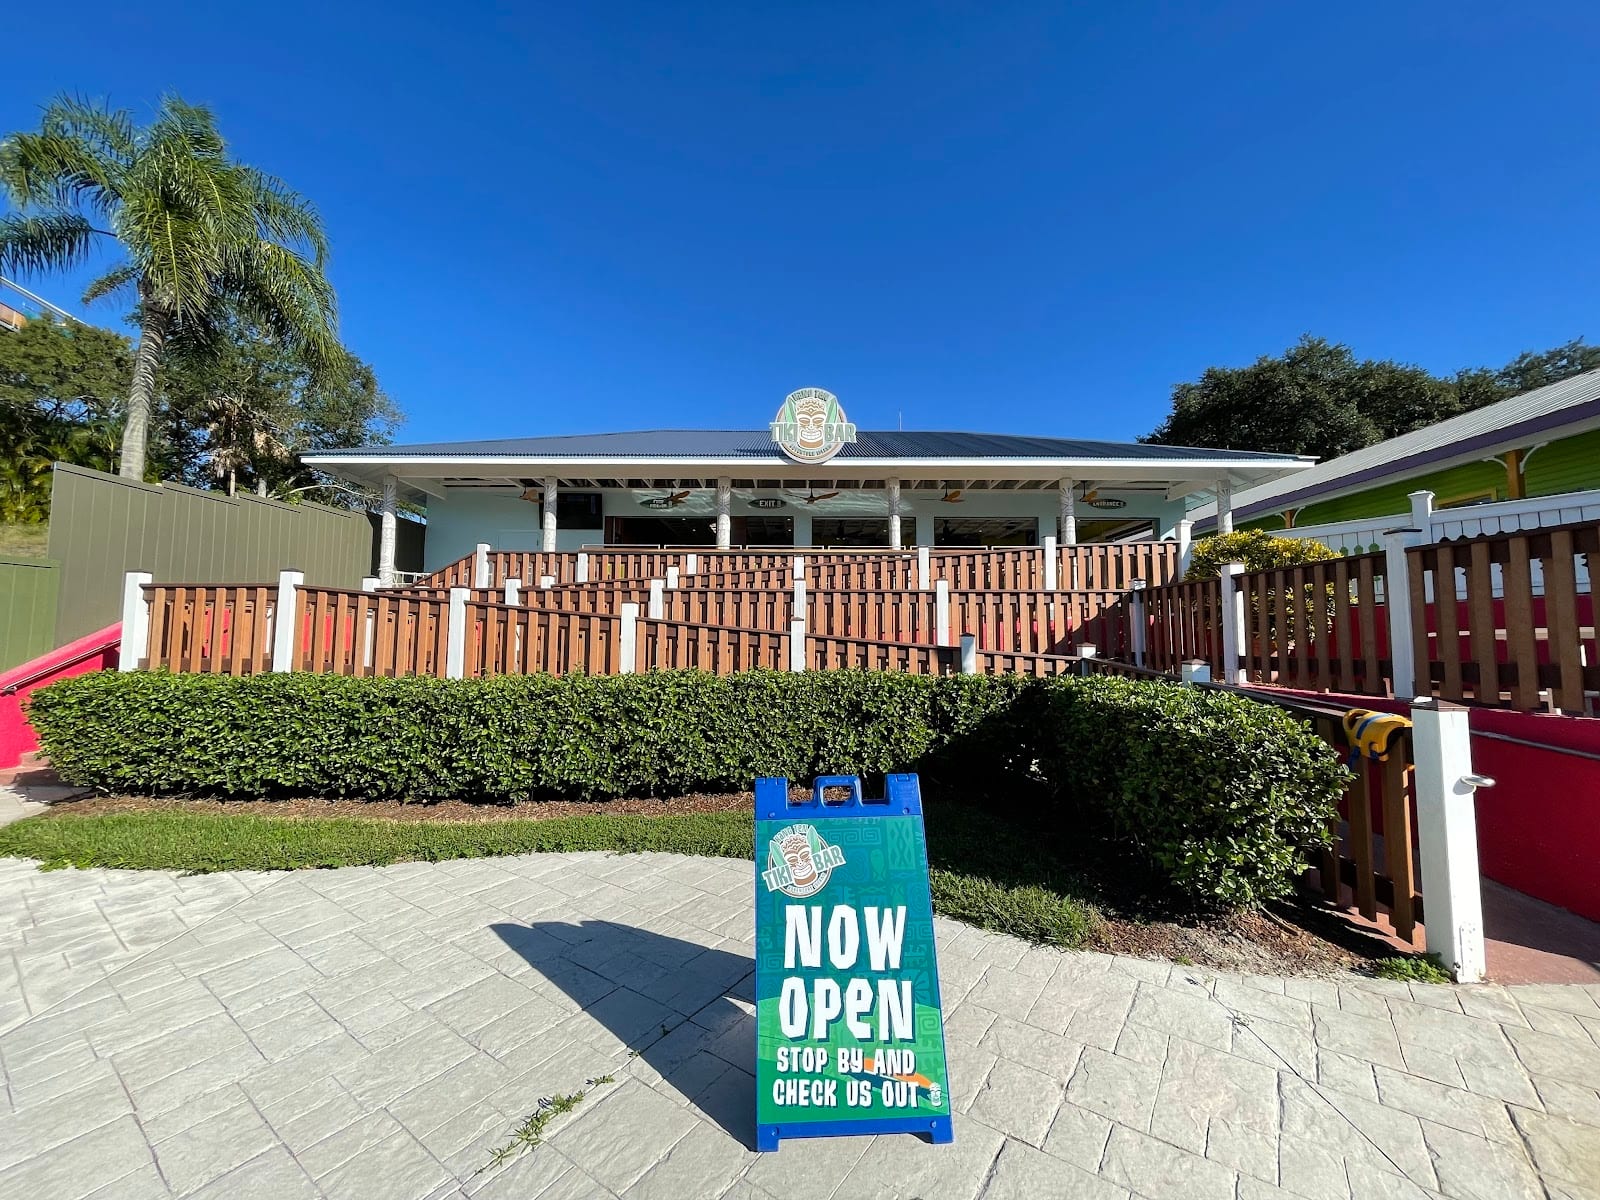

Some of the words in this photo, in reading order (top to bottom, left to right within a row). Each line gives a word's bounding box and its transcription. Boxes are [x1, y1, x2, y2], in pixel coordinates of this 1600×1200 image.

[769, 423, 799, 442] TIKI
[824, 423, 856, 443] BAR
[759, 500, 775, 508] EXIT
[762, 864, 793, 892] TIKI
[812, 846, 845, 872] BAR
[784, 904, 906, 971] NOW
[776, 1047, 828, 1073] STOP
[873, 1049, 915, 1075] AND
[773, 1078, 837, 1107] CHECK
[846, 1080, 872, 1107] US
[881, 1081, 919, 1108] OUT
